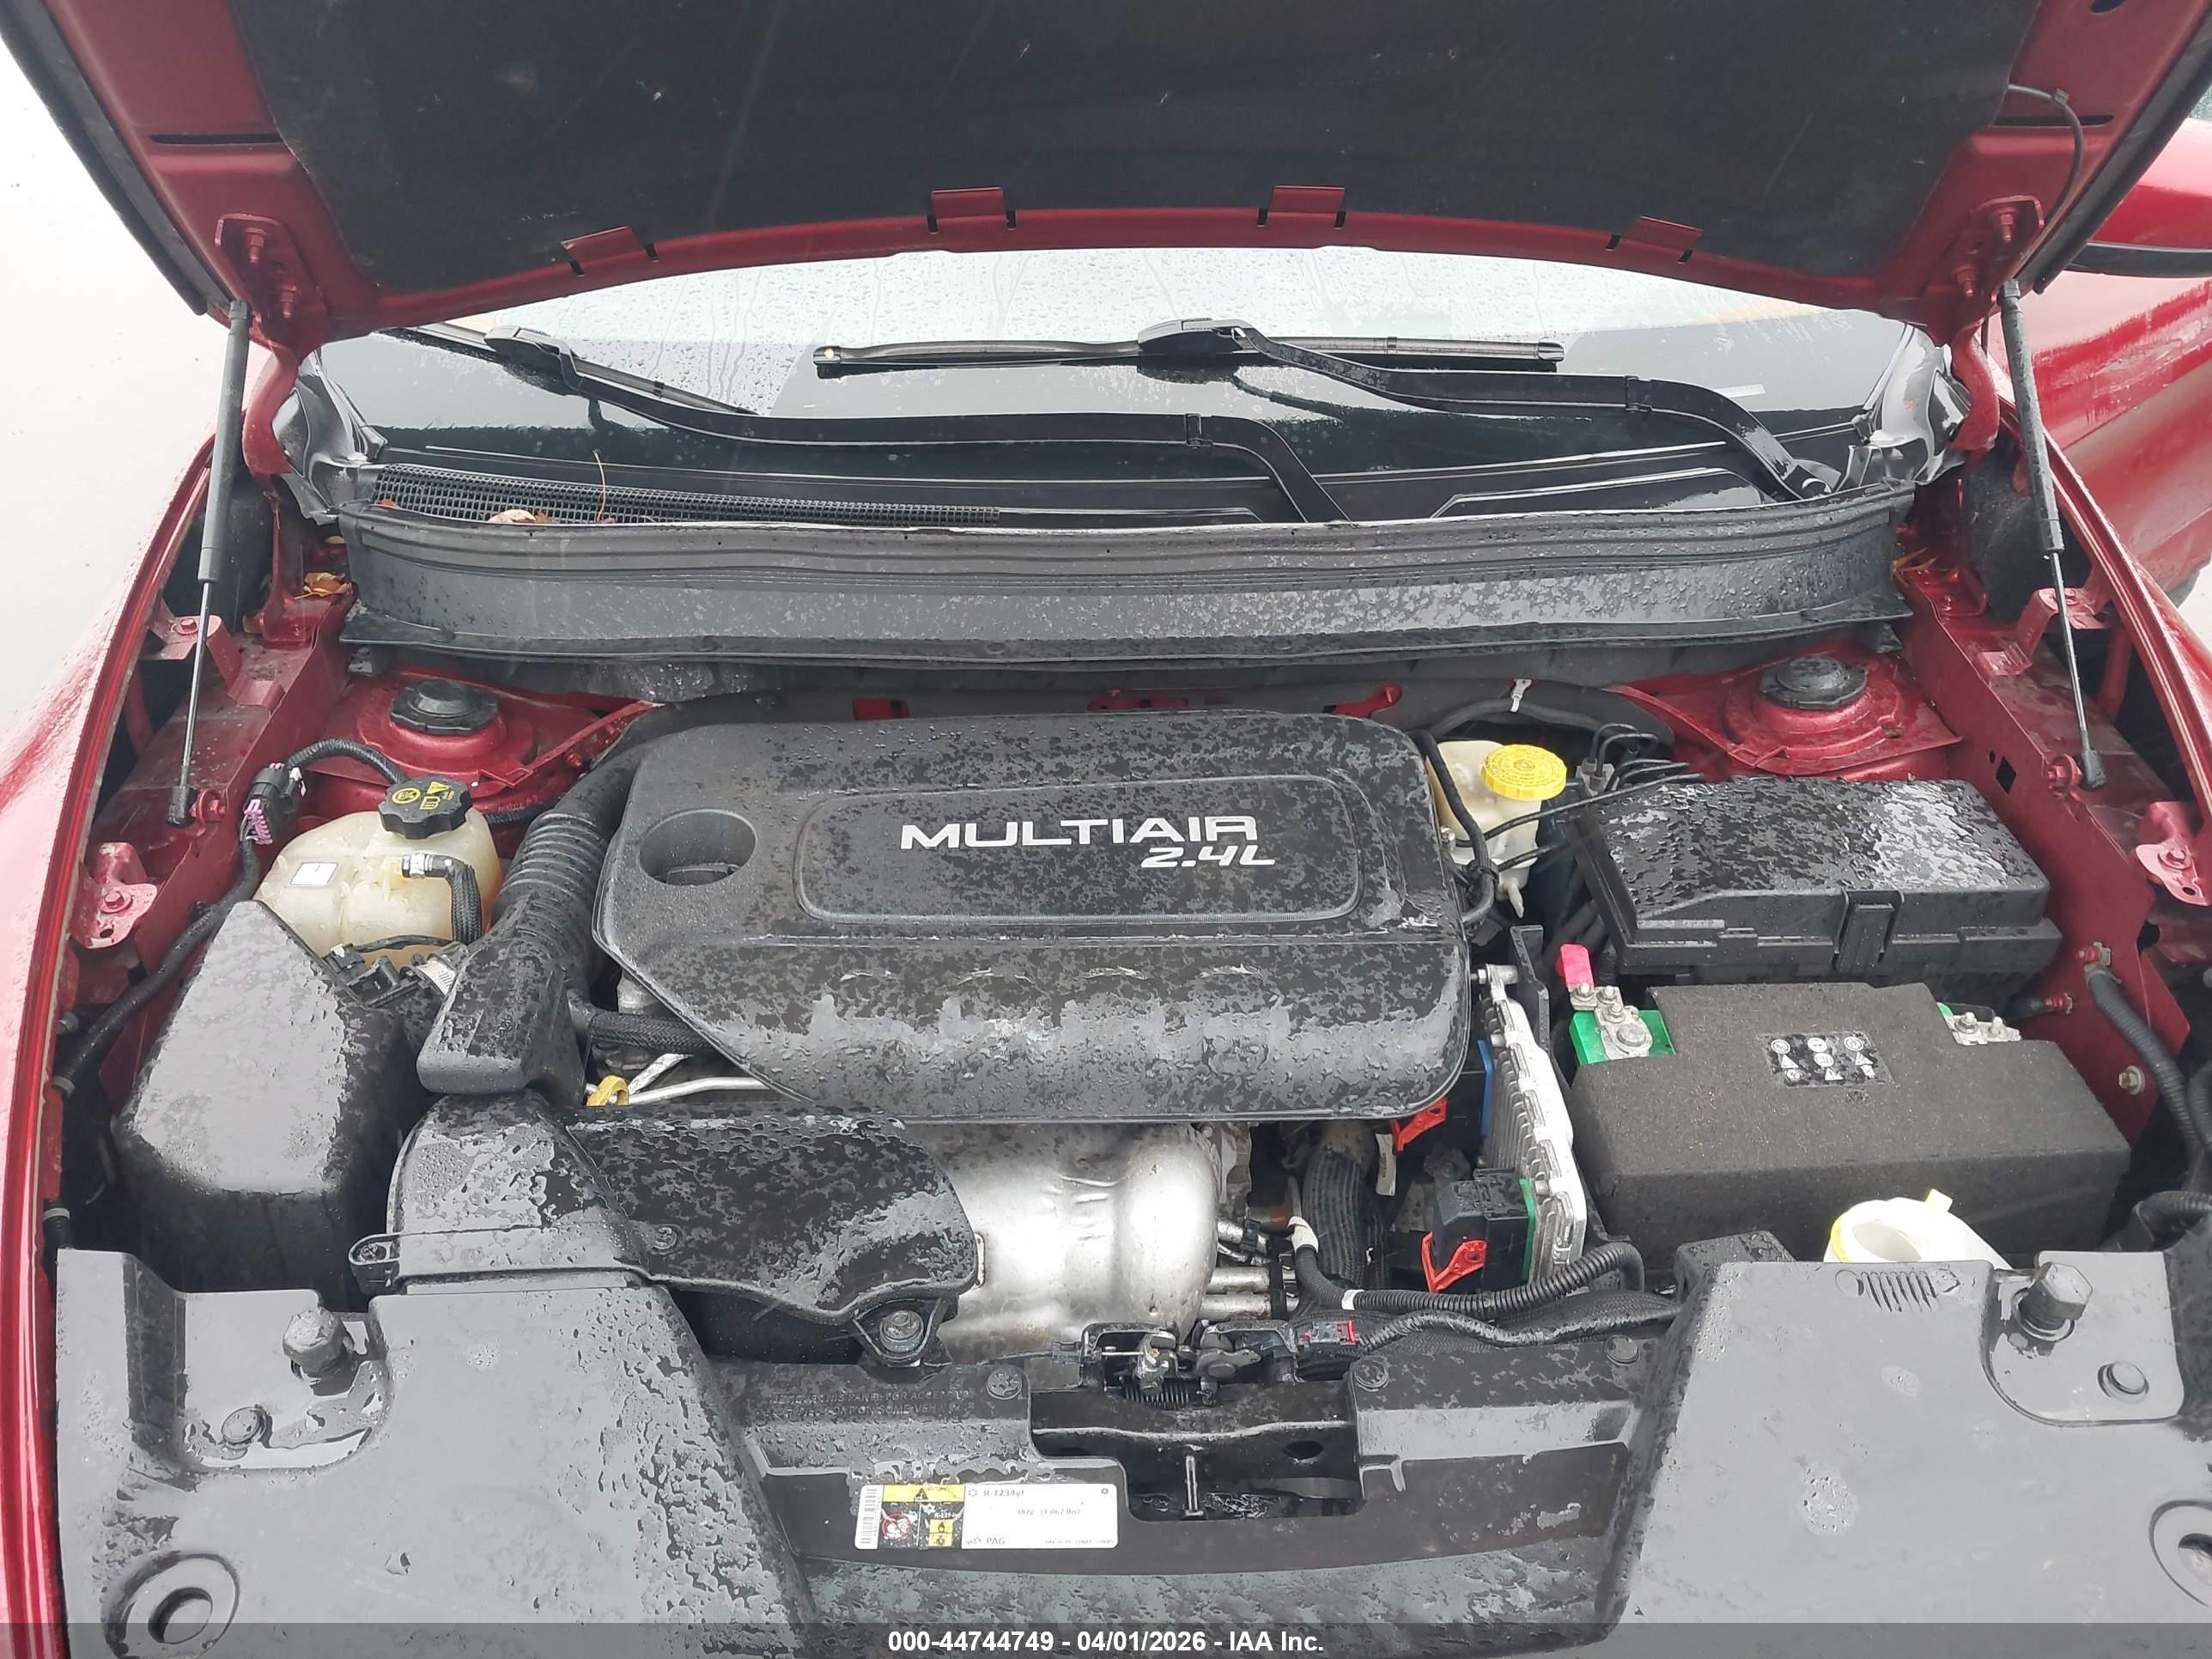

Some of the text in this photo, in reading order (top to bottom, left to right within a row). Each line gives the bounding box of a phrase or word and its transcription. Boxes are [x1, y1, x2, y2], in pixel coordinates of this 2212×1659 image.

[901, 816, 1257, 849] MULTIAIR
[1140, 844, 1276, 867] 2.4L
[986, 1536, 1006, 1545] PAG
